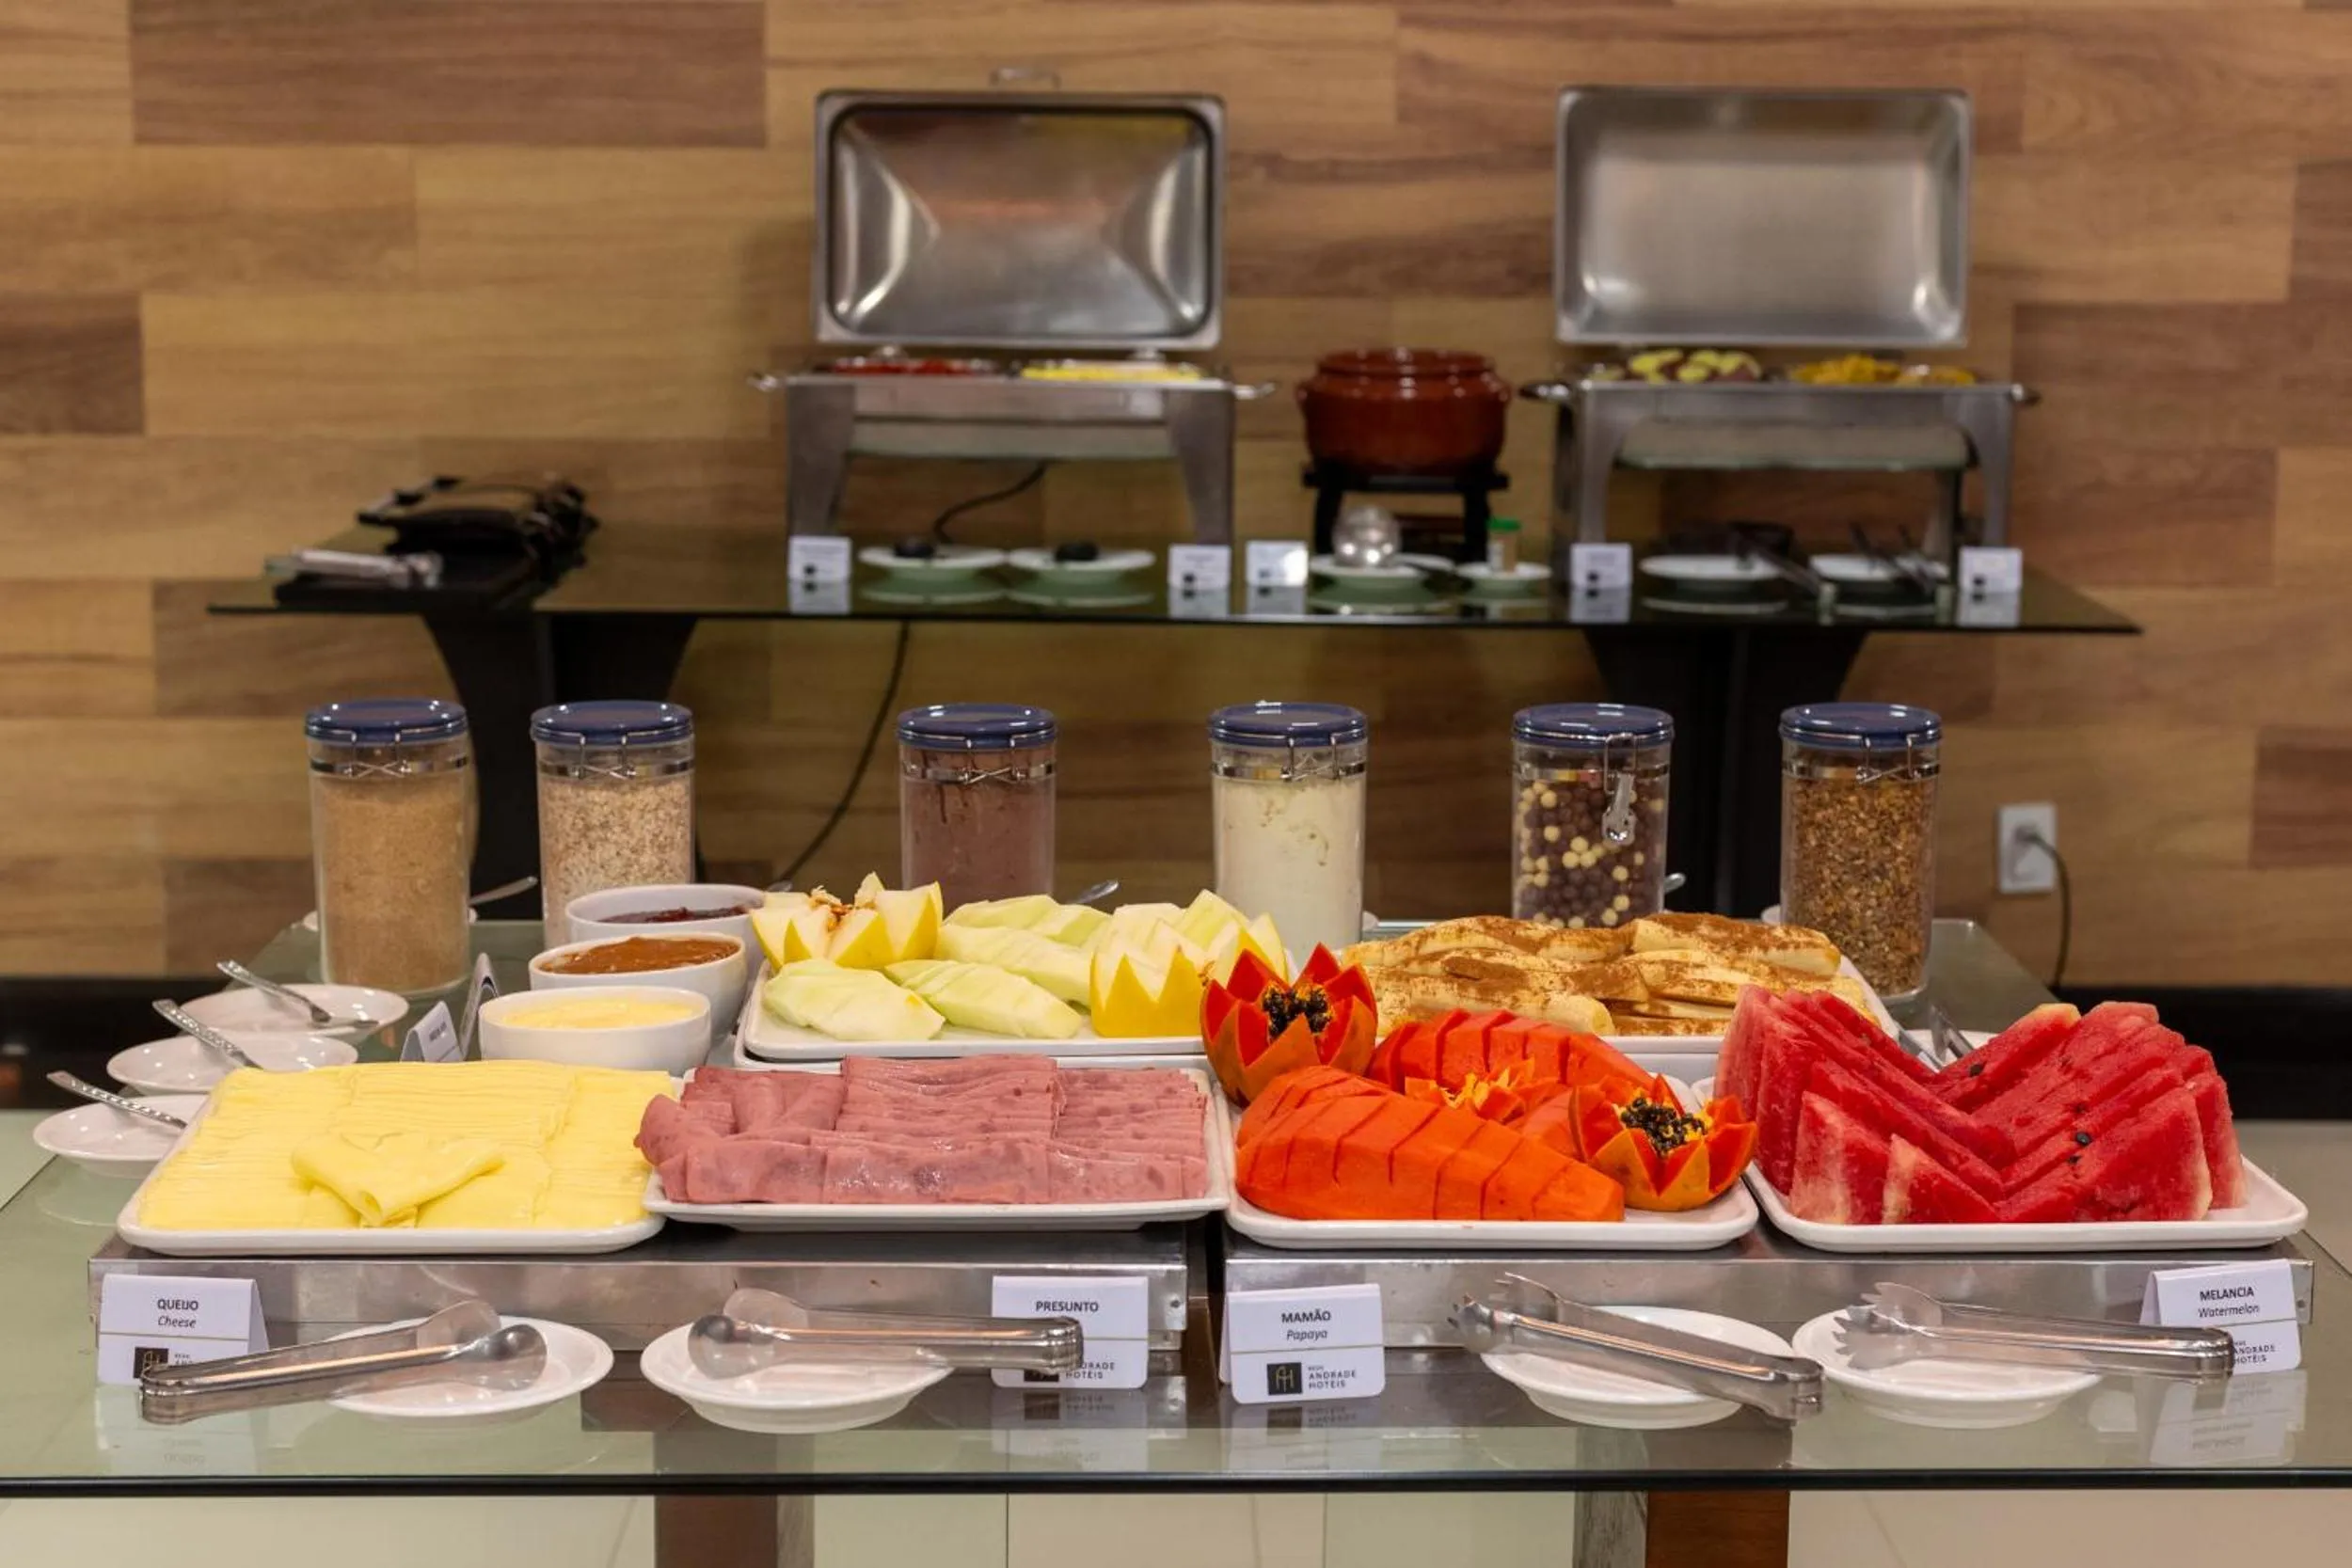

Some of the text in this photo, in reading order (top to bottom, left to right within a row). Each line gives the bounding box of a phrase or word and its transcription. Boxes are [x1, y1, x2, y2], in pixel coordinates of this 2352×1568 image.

[2200, 1286, 2254, 1301] MELANCIA
[157, 1298, 199, 1311] QUEIJO
[1035, 1301, 1100, 1313] PRESUNTO
[2198, 1303, 2260, 1318] Watermelon
[157, 1315, 197, 1328] Cheese
[1280, 1308, 1331, 1323] MAMÃO
[1286, 1329, 1328, 1342] Papaya
[1309, 1370, 1356, 1380] ANDRADE
